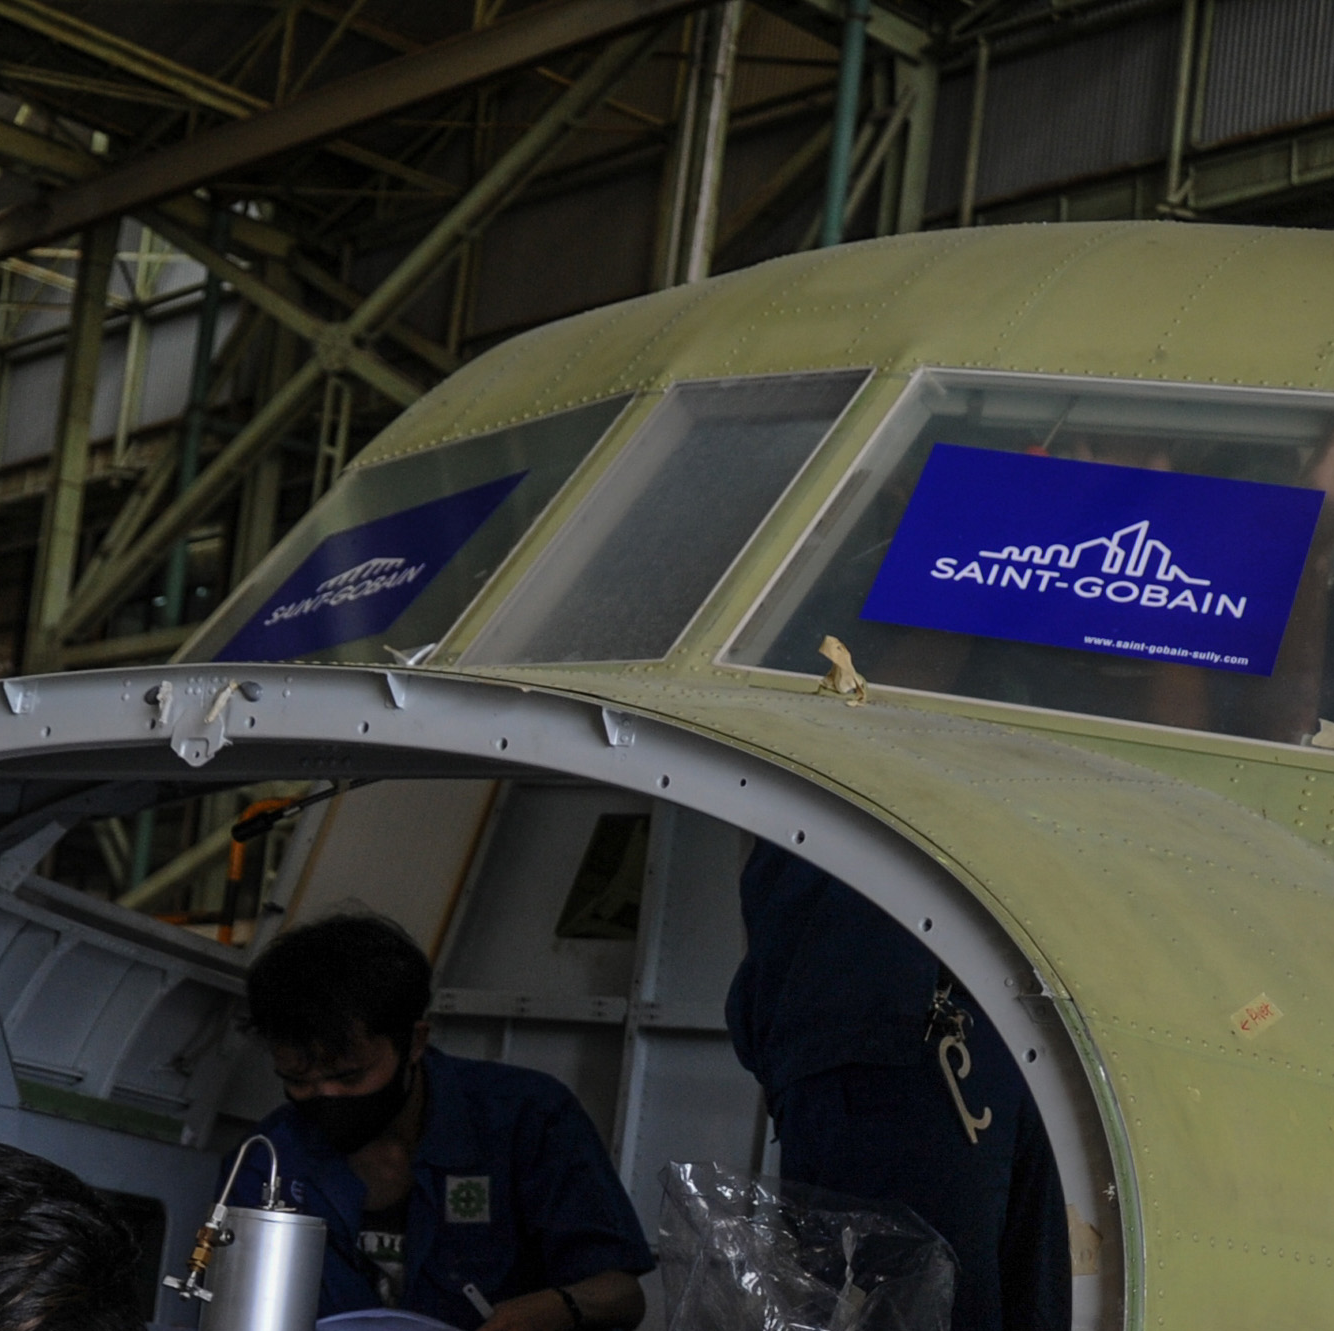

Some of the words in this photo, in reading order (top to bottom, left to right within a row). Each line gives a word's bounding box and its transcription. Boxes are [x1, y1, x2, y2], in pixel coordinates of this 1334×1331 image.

[264, 563, 425, 625] SAINT-GOBAIN
[931, 557, 1247, 619] SAINT-GOBAIN
[1084, 635, 1249, 666] www.saint-gobain-sully.com
